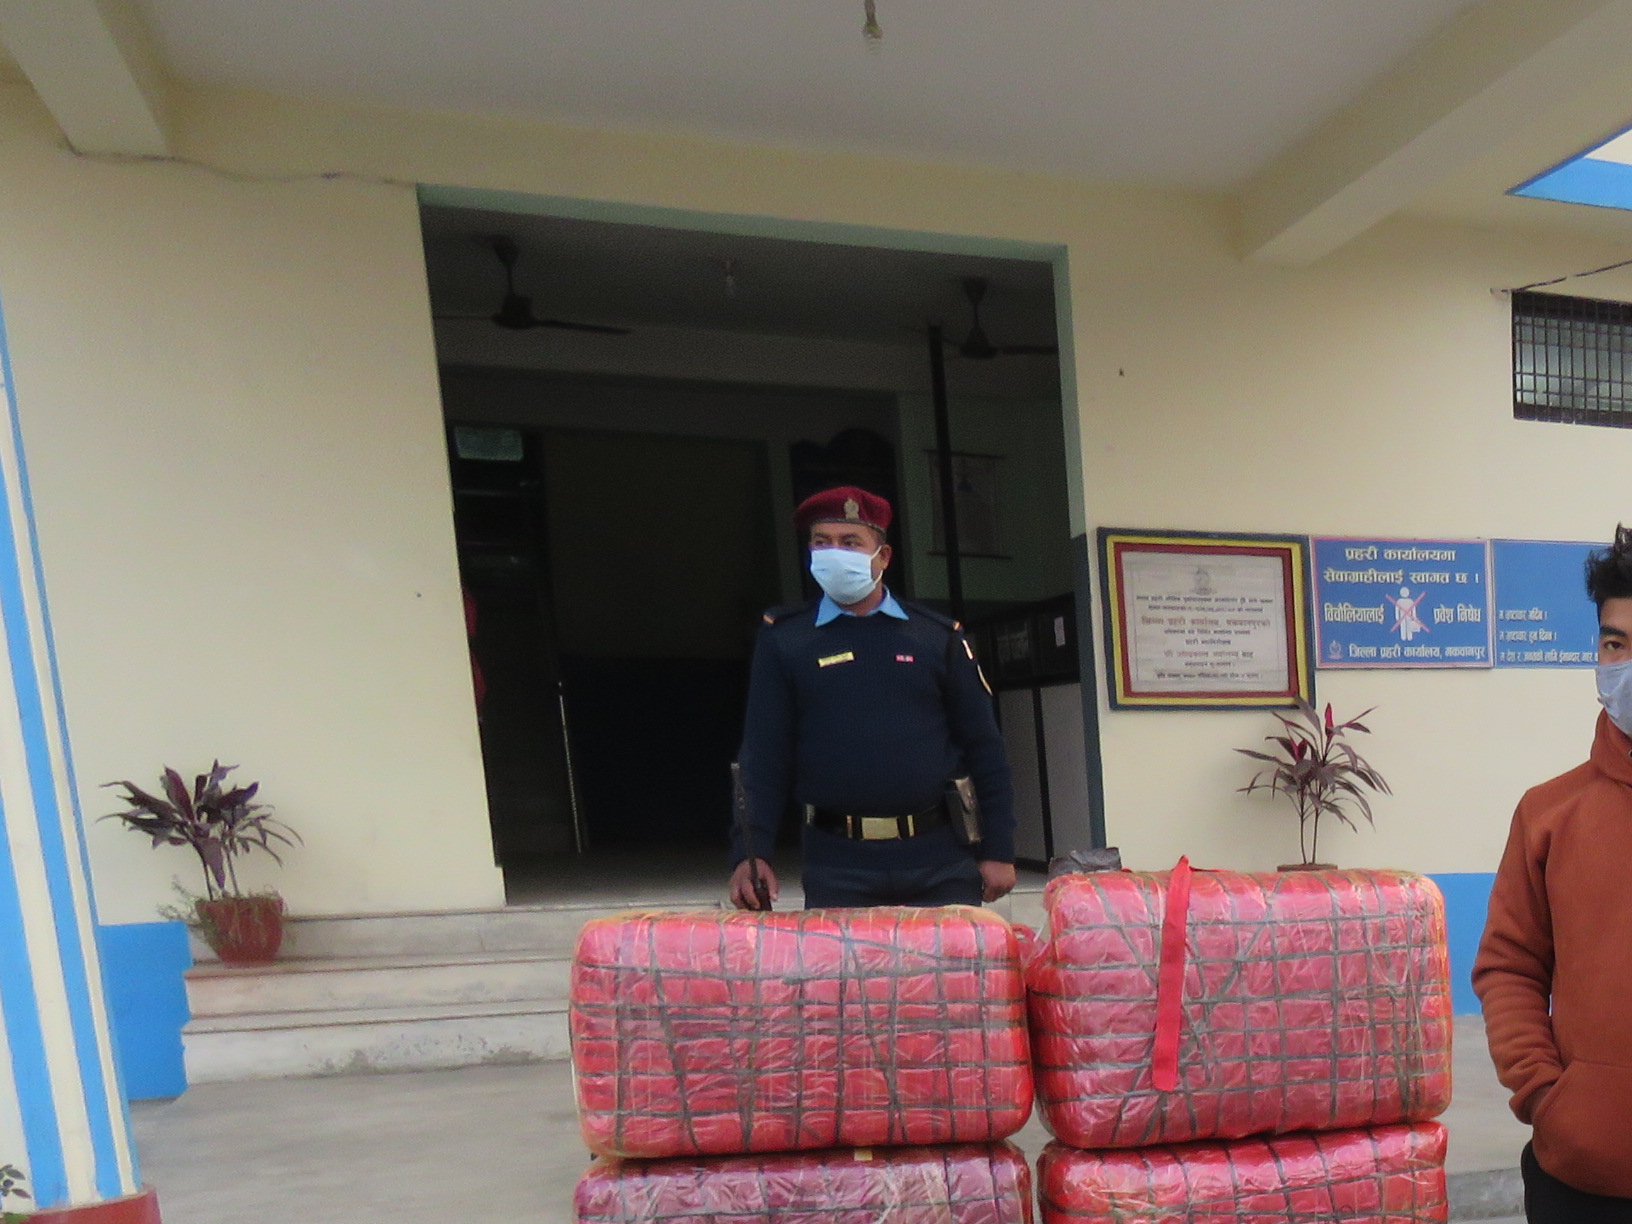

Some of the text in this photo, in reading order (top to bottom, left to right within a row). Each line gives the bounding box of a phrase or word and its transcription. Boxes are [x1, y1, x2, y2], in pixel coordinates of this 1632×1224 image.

[1344, 545, 1456, 562] प्रहरी कार्यालयमा
[1409, 571, 1450, 584] स्वागत
[1455, 571, 1468, 584] छ
[1433, 603, 1454, 625] प्रवेश
[1456, 603, 1482, 624] निषेध
[1349, 643, 1377, 659] जिल्ला
[1379, 643, 1402, 660] प्रहरी
[1444, 646, 1486, 661] मकवानपुर
